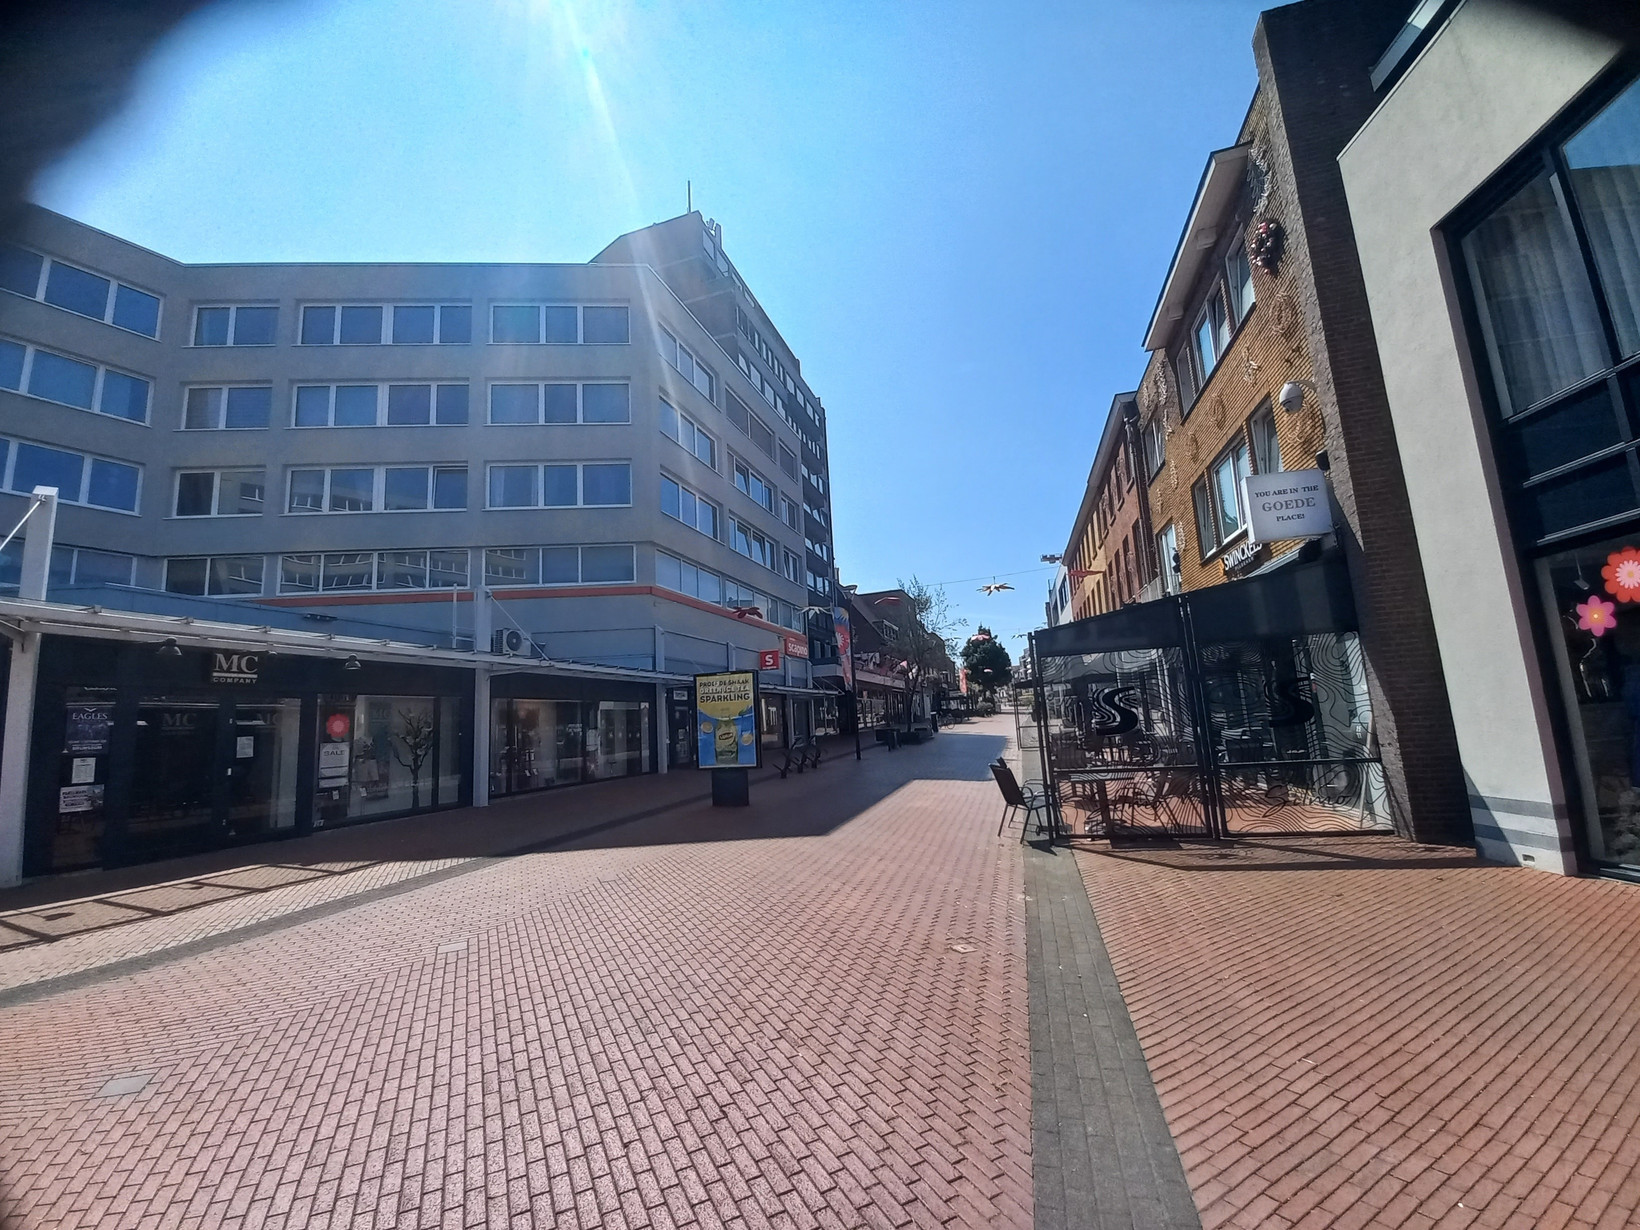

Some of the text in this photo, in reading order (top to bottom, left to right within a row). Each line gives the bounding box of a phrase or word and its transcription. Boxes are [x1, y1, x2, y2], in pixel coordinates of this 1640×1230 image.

[1301, 484, 1319, 492] THE
[1262, 497, 1316, 512] GOEDE
[1276, 513, 1305, 522] PLACE!
[213, 653, 258, 673] MC
[764, 654, 774, 666] S
[700, 693, 750, 703] SPARKLING
[72, 712, 108, 720] EAGLES
